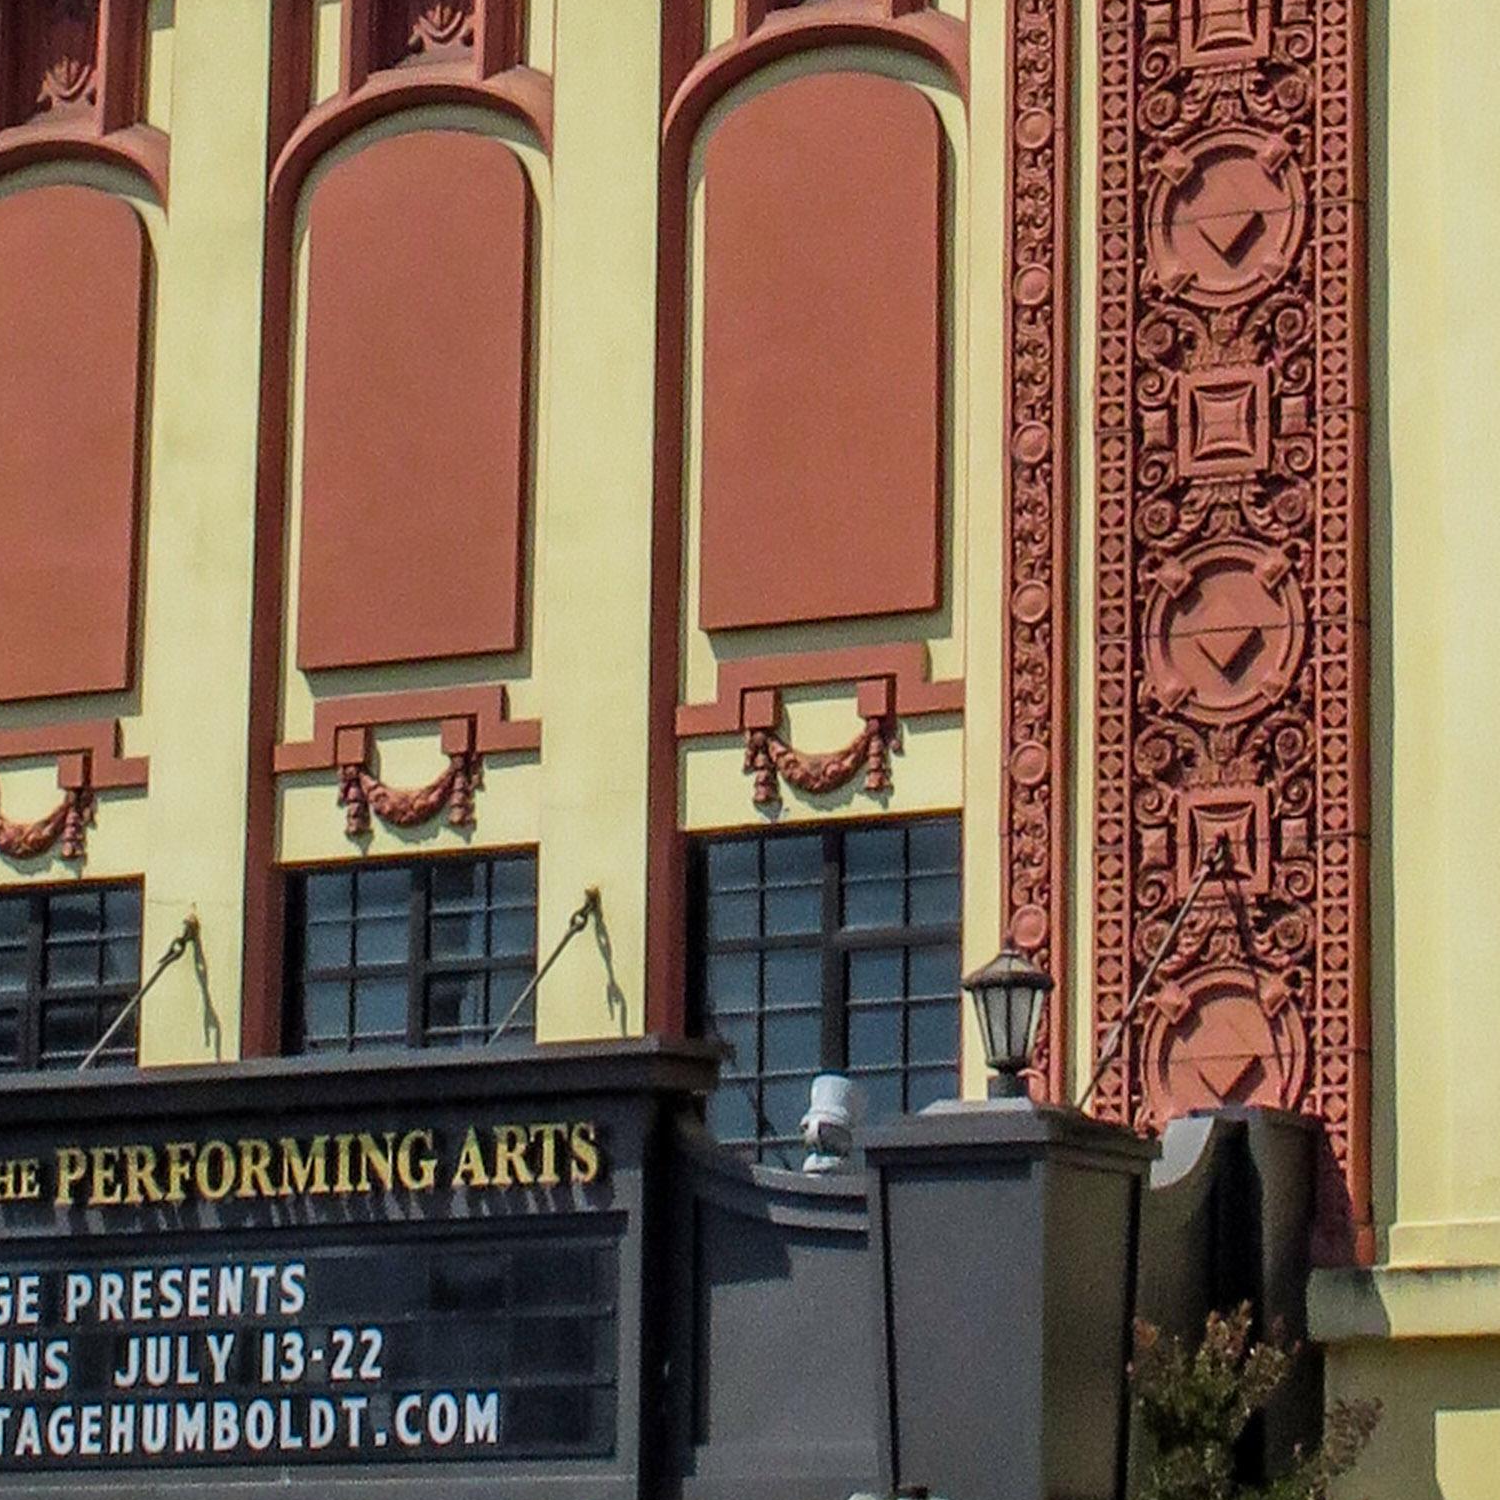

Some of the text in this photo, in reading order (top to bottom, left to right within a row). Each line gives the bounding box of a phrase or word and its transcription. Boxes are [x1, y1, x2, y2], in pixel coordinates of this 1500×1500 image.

[54, 1129, 438, 1206] PERFORMING
[452, 1120, 601, 1189] ARTS
[65, 1264, 307, 1323] PRESENTS
[114, 1333, 235, 1388] JULY
[261, 1328, 384, 1384] 13-22
